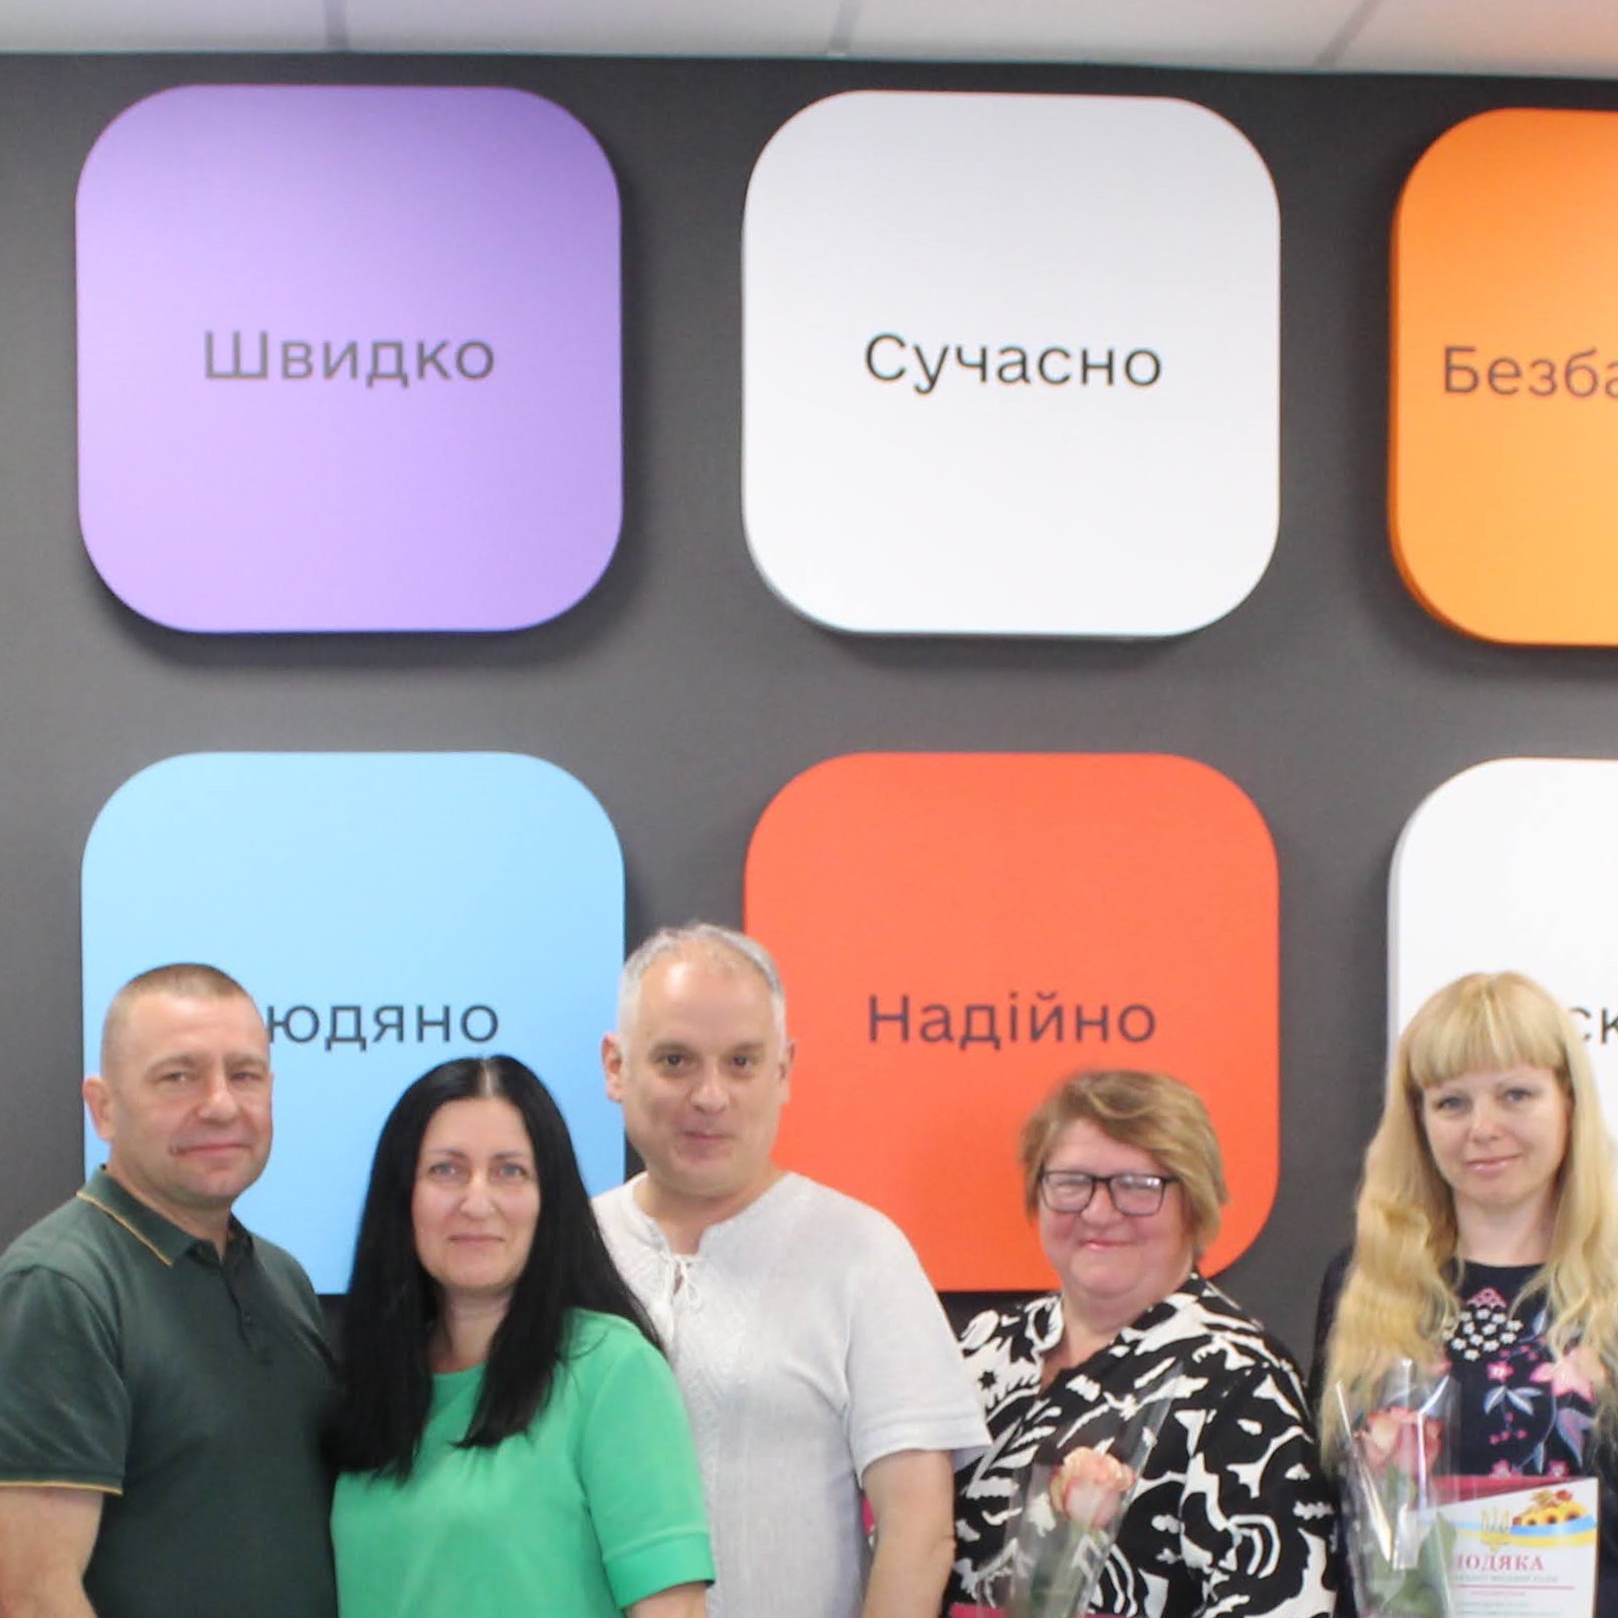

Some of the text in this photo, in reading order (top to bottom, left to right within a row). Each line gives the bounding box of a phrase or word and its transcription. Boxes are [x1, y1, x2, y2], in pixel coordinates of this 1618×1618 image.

[206, 331, 495, 389] Швидко
[864, 332, 1163, 396] Сучасно
[267, 1004, 500, 1053] юдяно
[869, 992, 1155, 1051] Надійно
